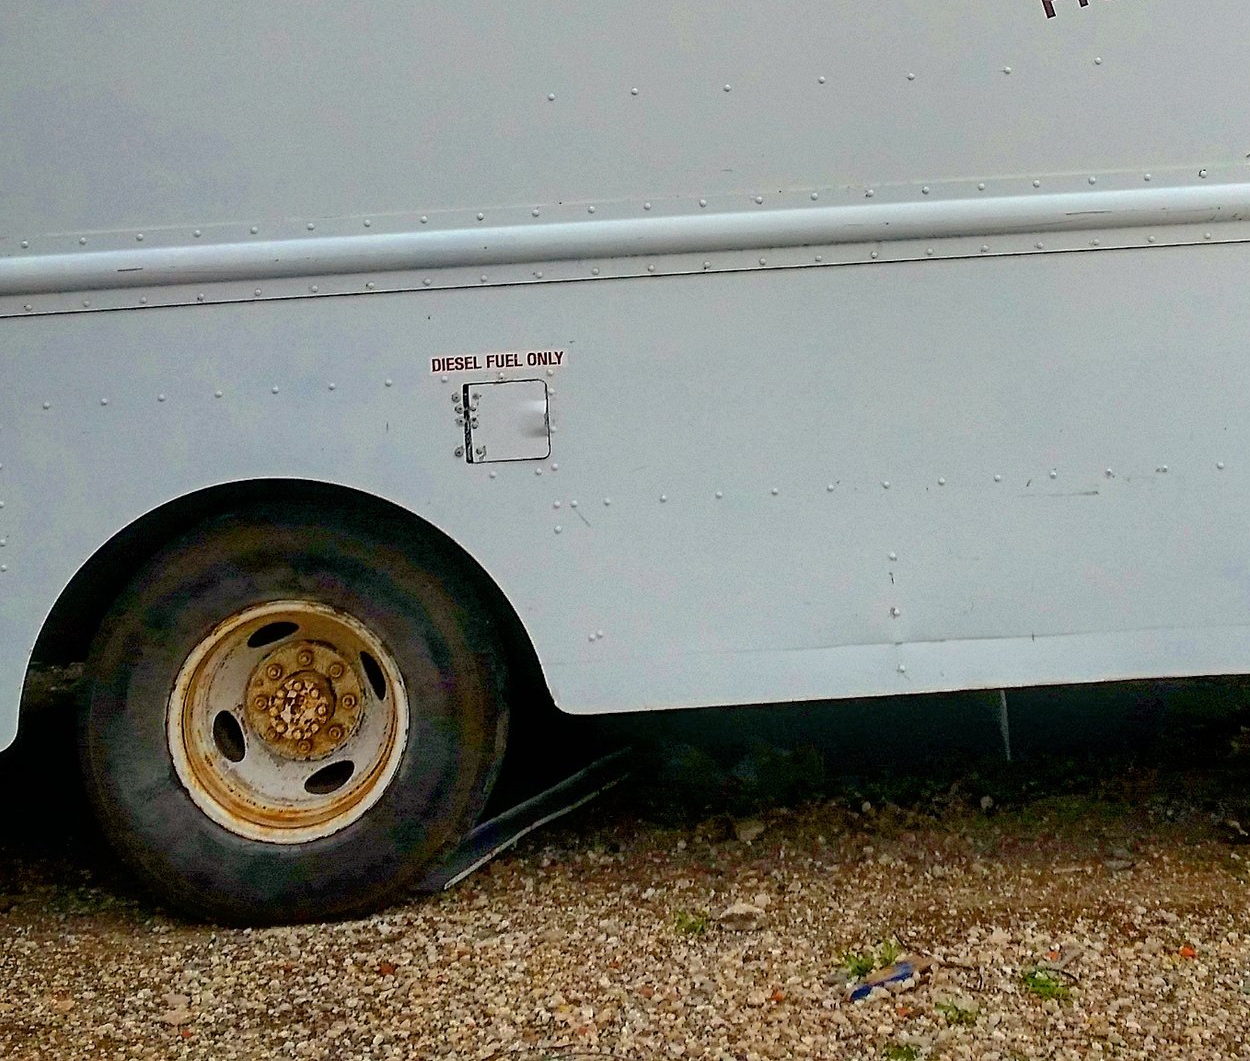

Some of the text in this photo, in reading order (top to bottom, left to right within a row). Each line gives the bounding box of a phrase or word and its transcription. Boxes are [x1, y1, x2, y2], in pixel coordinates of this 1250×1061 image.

[431, 352, 563, 372] DIESEL FUEL ONLY
